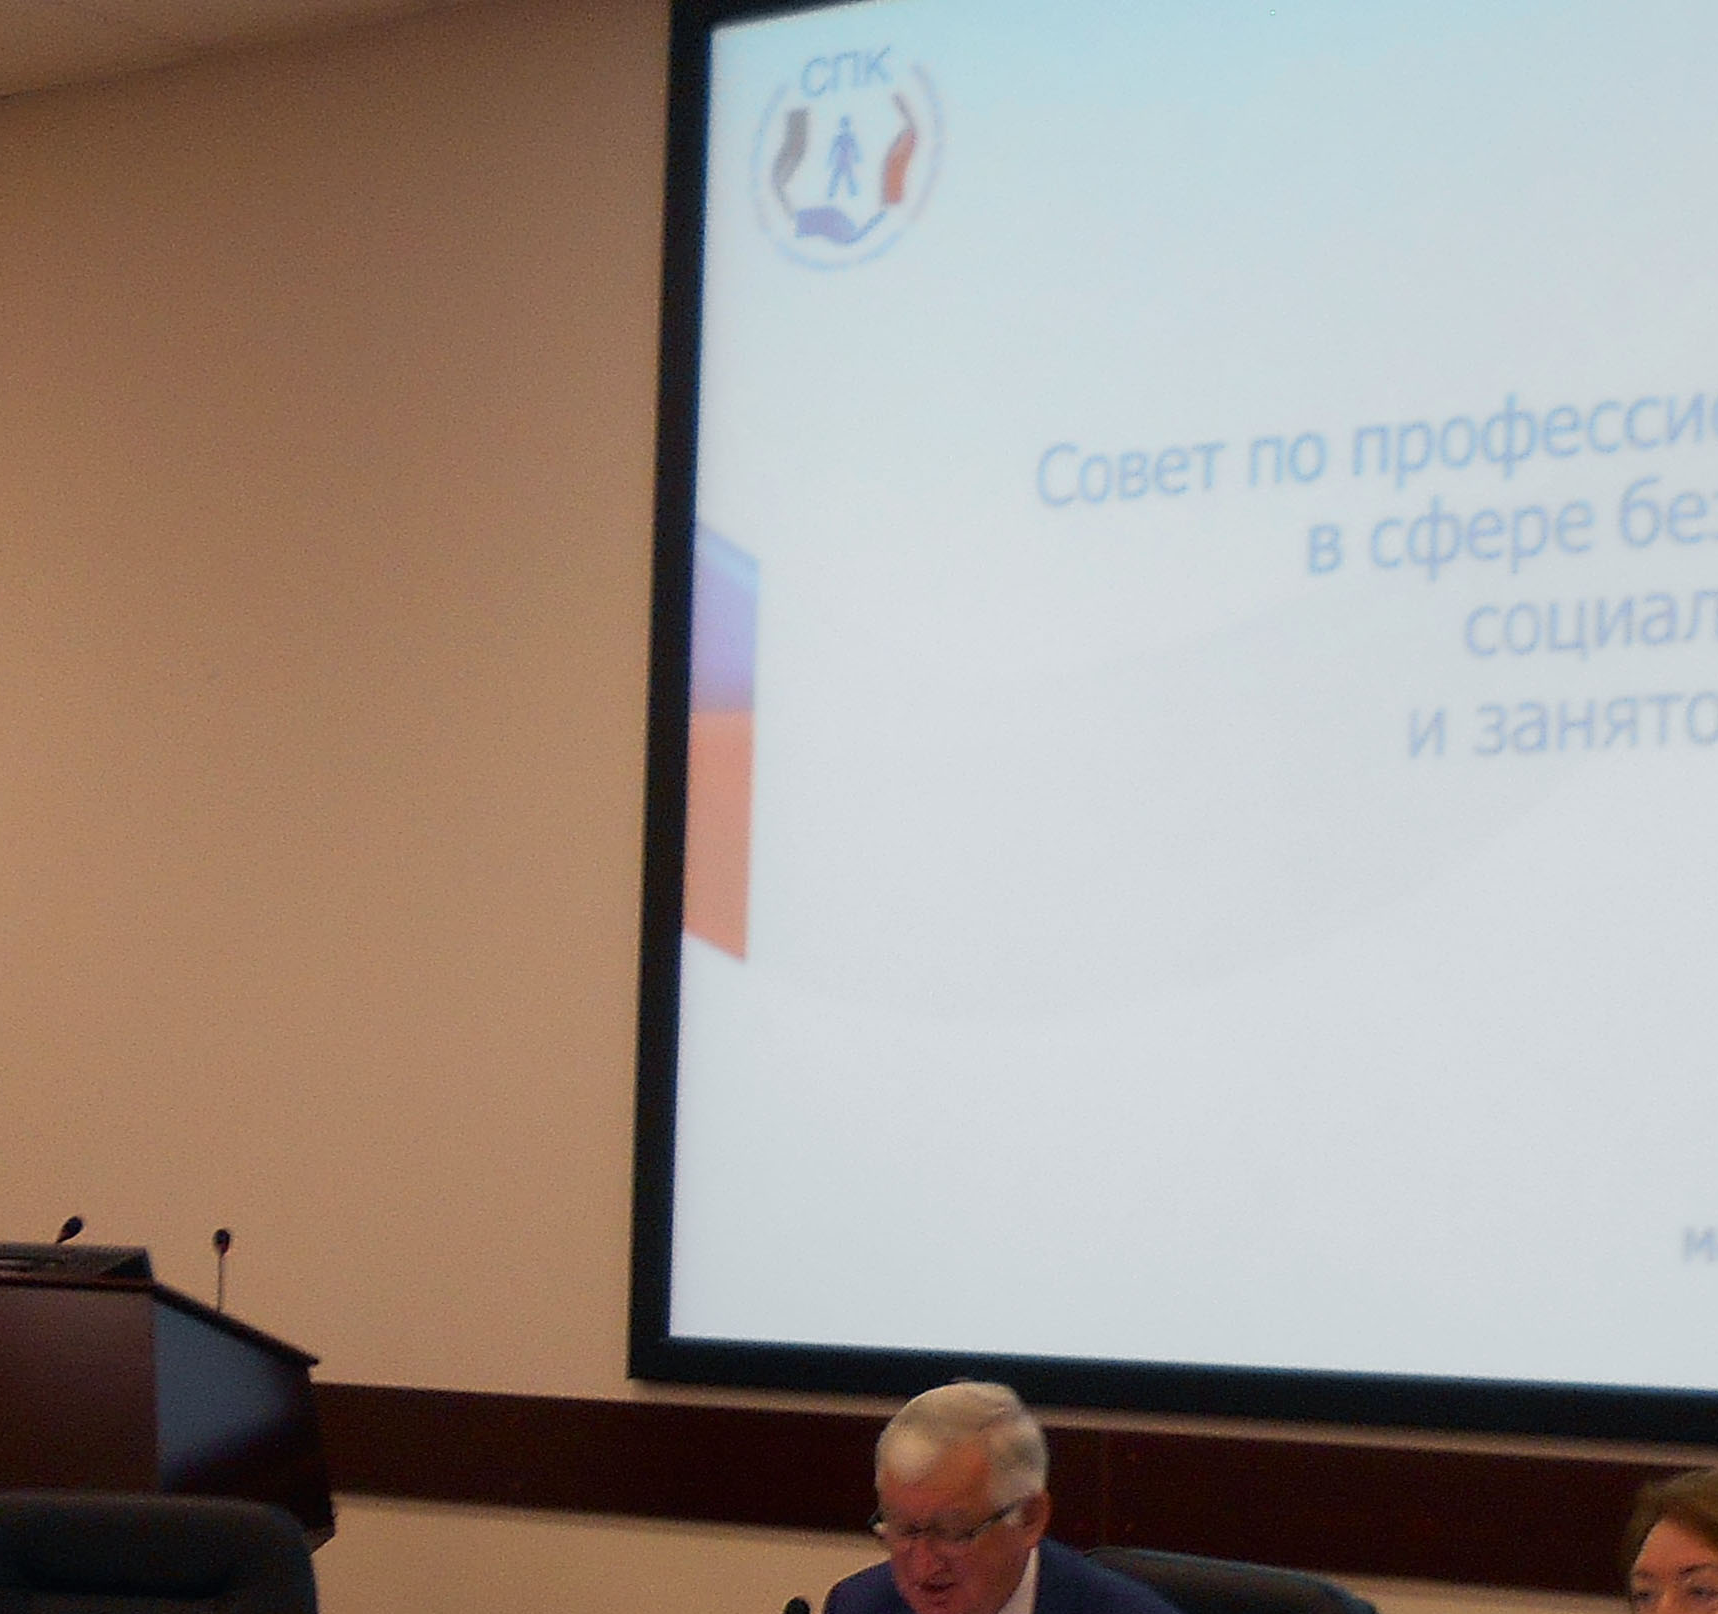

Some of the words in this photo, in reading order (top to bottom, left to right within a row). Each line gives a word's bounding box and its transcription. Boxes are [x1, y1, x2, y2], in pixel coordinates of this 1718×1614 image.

[801, 46, 894, 98] СПК
[1035, 434, 1226, 510] Совет
[1247, 429, 1328, 490] по
[1304, 521, 1344, 576] в
[1369, 495, 1595, 581] сфере
[1406, 706, 1447, 760] и
